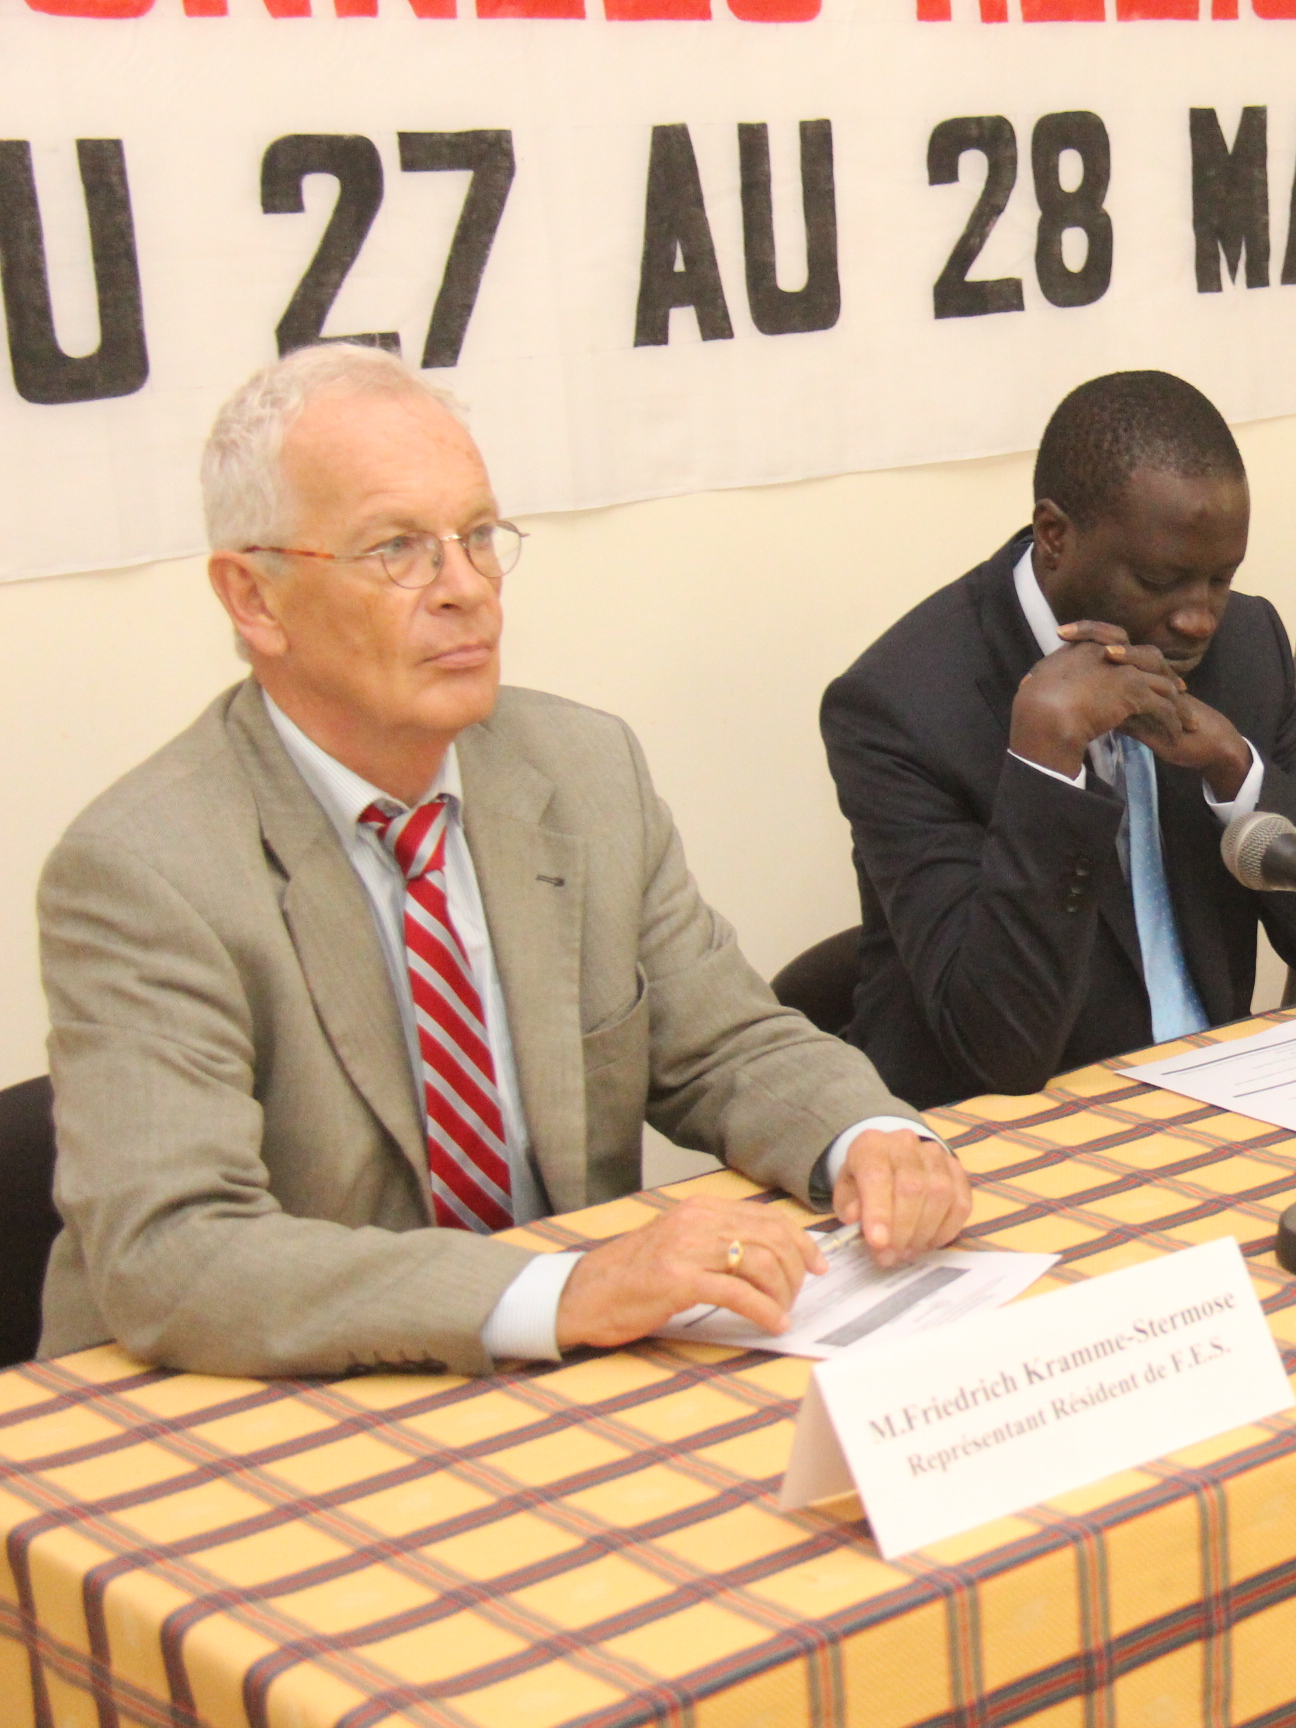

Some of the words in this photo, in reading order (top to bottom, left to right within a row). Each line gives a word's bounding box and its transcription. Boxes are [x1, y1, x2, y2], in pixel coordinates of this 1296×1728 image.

[260, 129, 516, 369] 27
[633, 118, 842, 348] AU
[926, 110, 1114, 319] 28
[868, 1370, 1018, 1443] M.Friedrich
[1022, 1292, 1237, 1385] Kramme-Stermose
[907, 1409, 1048, 1477] Représentant
[1050, 1373, 1140, 1421] Résident
[1144, 1362, 1167, 1385] de
[1170, 1336, 1232, 1374] F.E.S.
